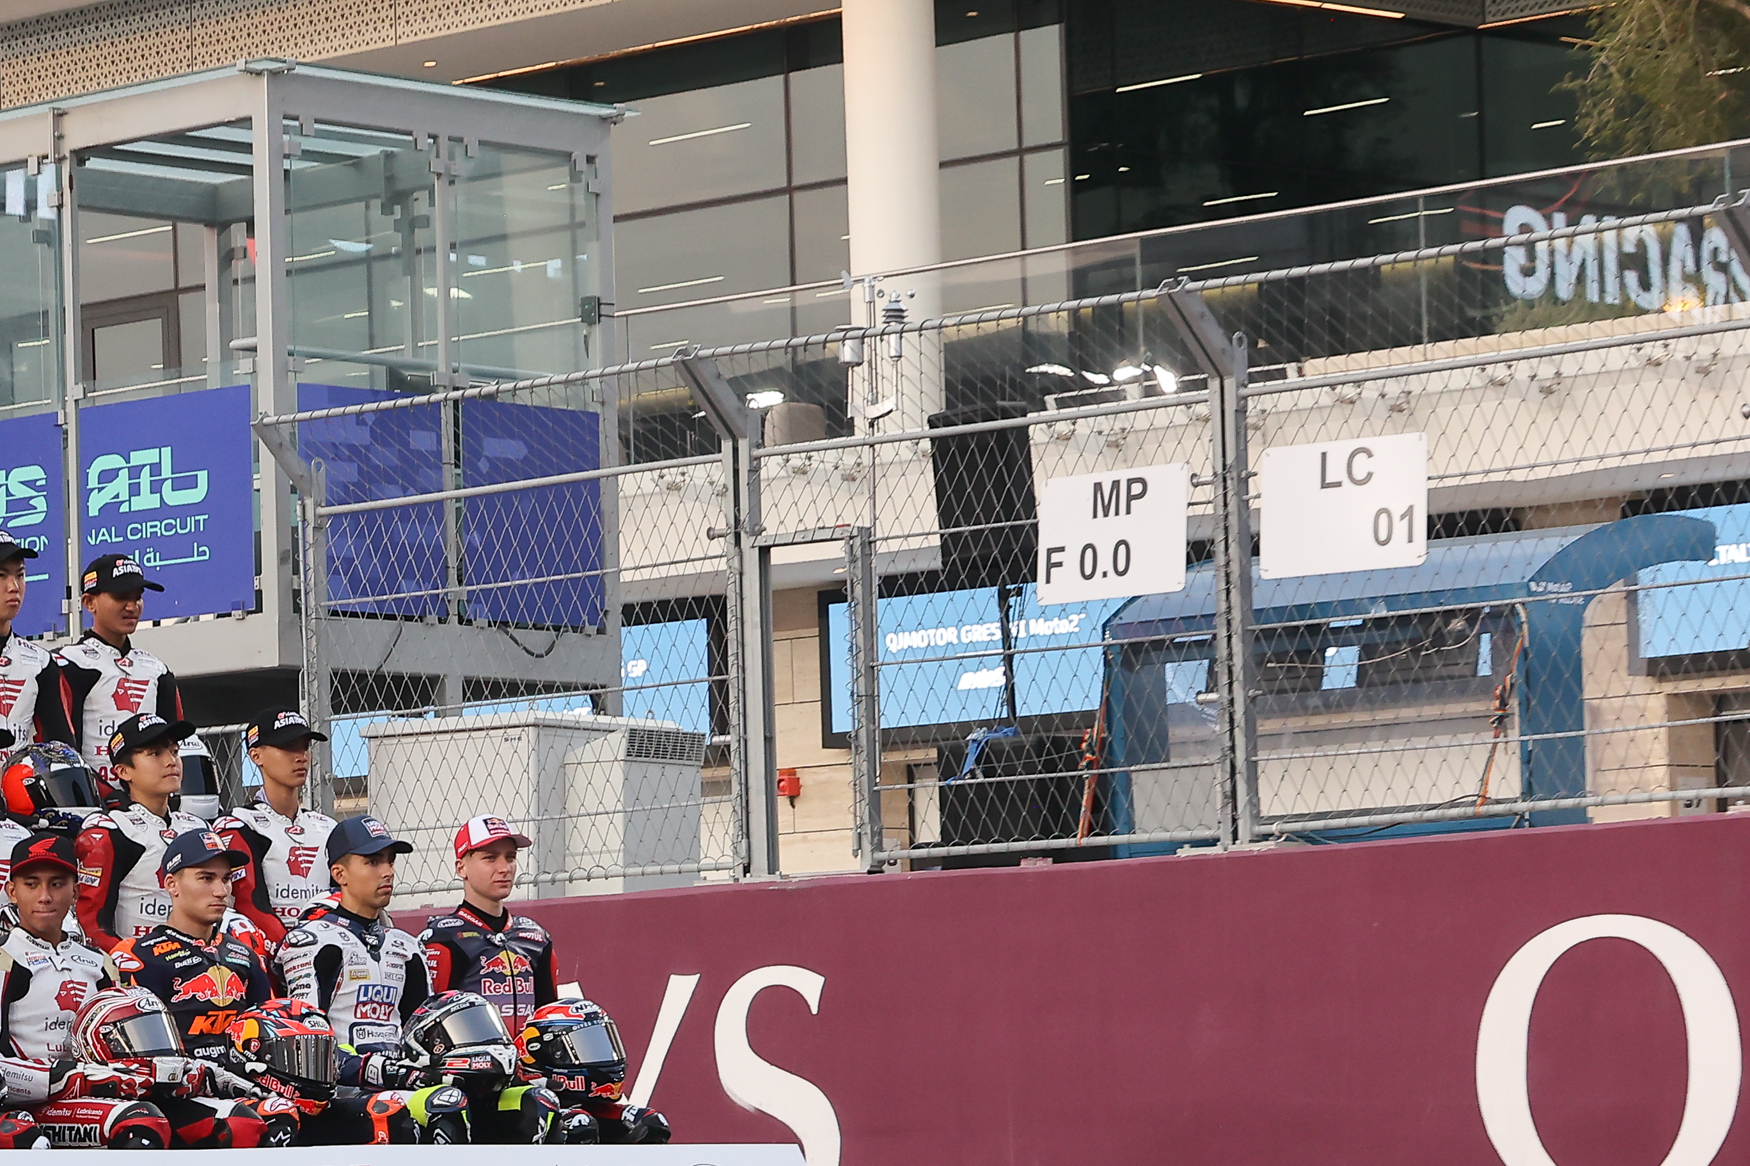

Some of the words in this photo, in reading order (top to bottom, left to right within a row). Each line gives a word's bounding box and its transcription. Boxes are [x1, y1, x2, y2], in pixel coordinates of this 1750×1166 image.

[1319, 447, 1374, 489] LC
[1092, 477, 1148, 519] MP
[127, 514, 209, 539] CIRCUIT
[1372, 505, 1416, 547] 01
[1044, 546, 1064, 584] F
[1079, 539, 1132, 582] 0.0
[152, 941, 182, 956] KTM
[359, 986, 397, 1003] LIQUI
[482, 978, 511, 994] Red
[356, 1003, 394, 1020] MOLY
